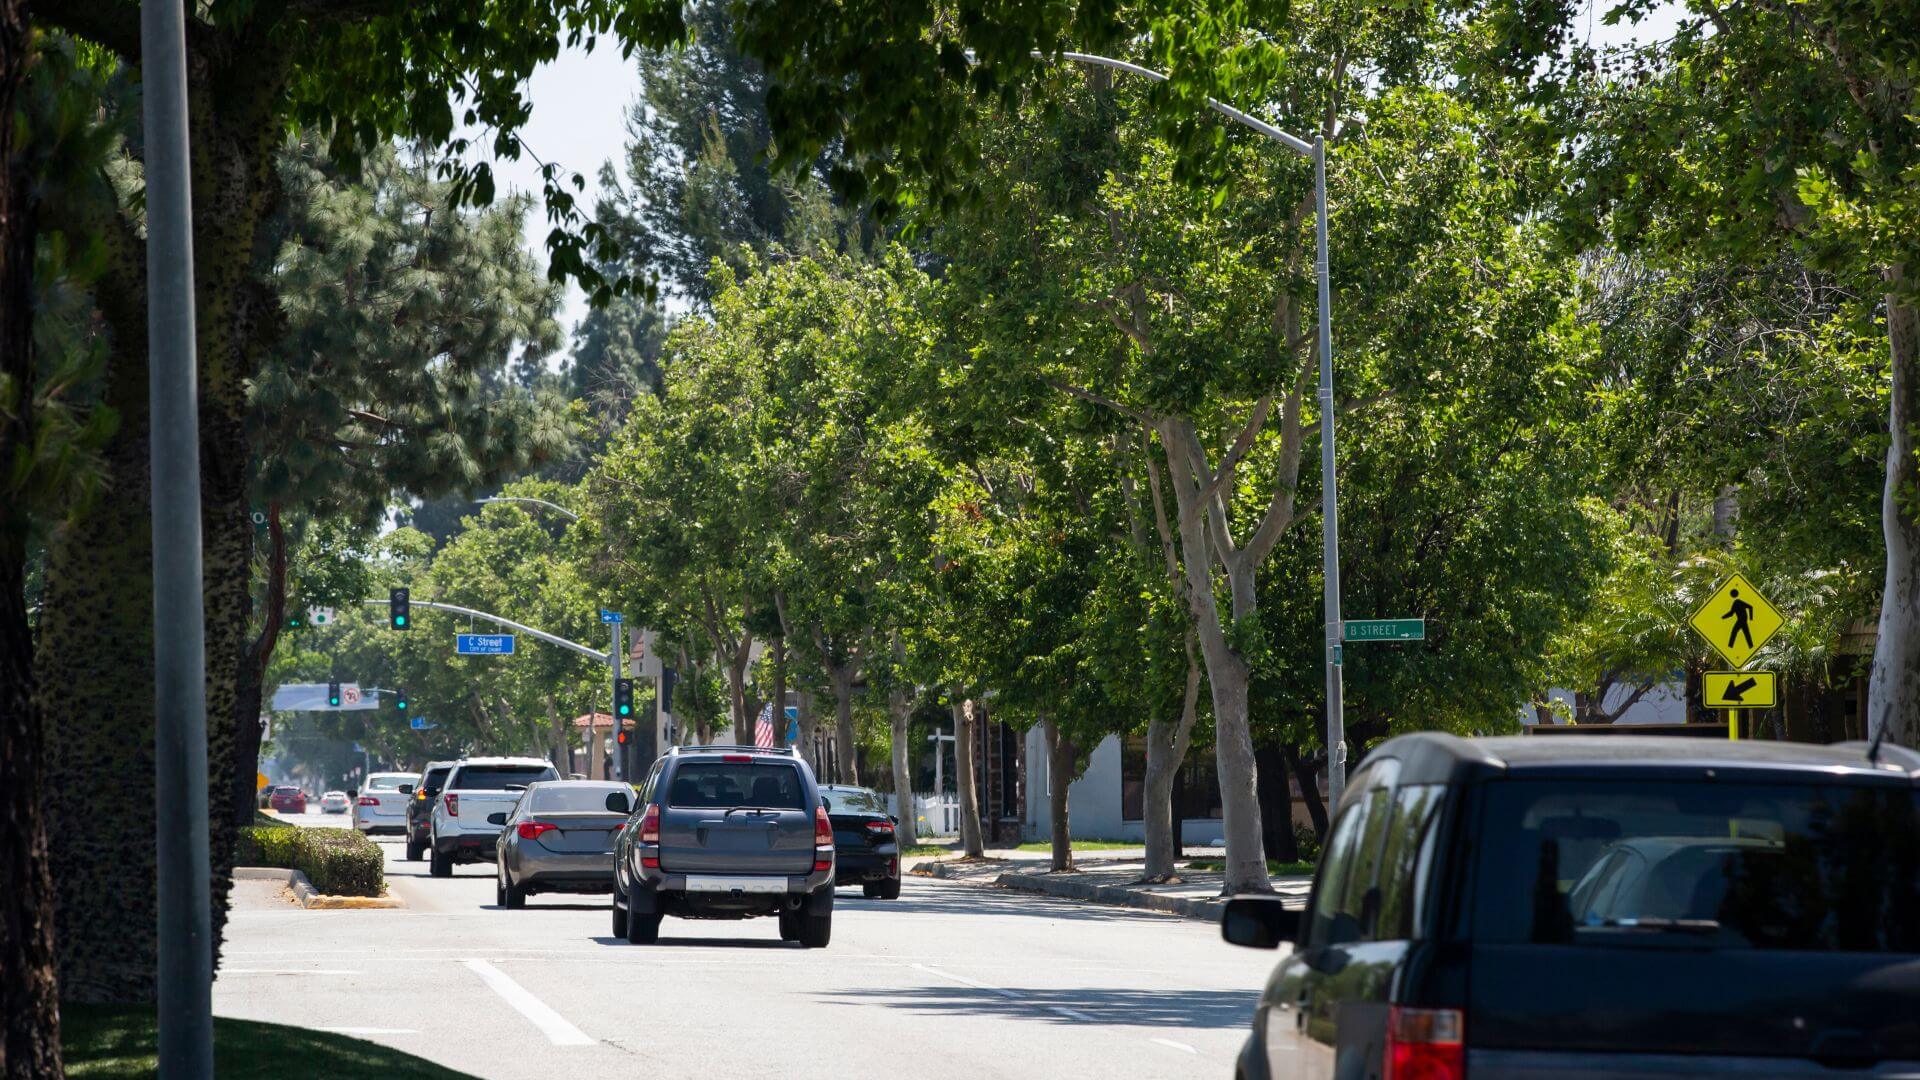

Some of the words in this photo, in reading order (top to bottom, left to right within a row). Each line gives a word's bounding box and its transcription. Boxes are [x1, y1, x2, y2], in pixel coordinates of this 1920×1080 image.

[1350, 625, 1357, 636] B
[1360, 624, 1398, 636] STREET
[468, 637, 474, 647] C
[477, 637, 503, 647] Street
